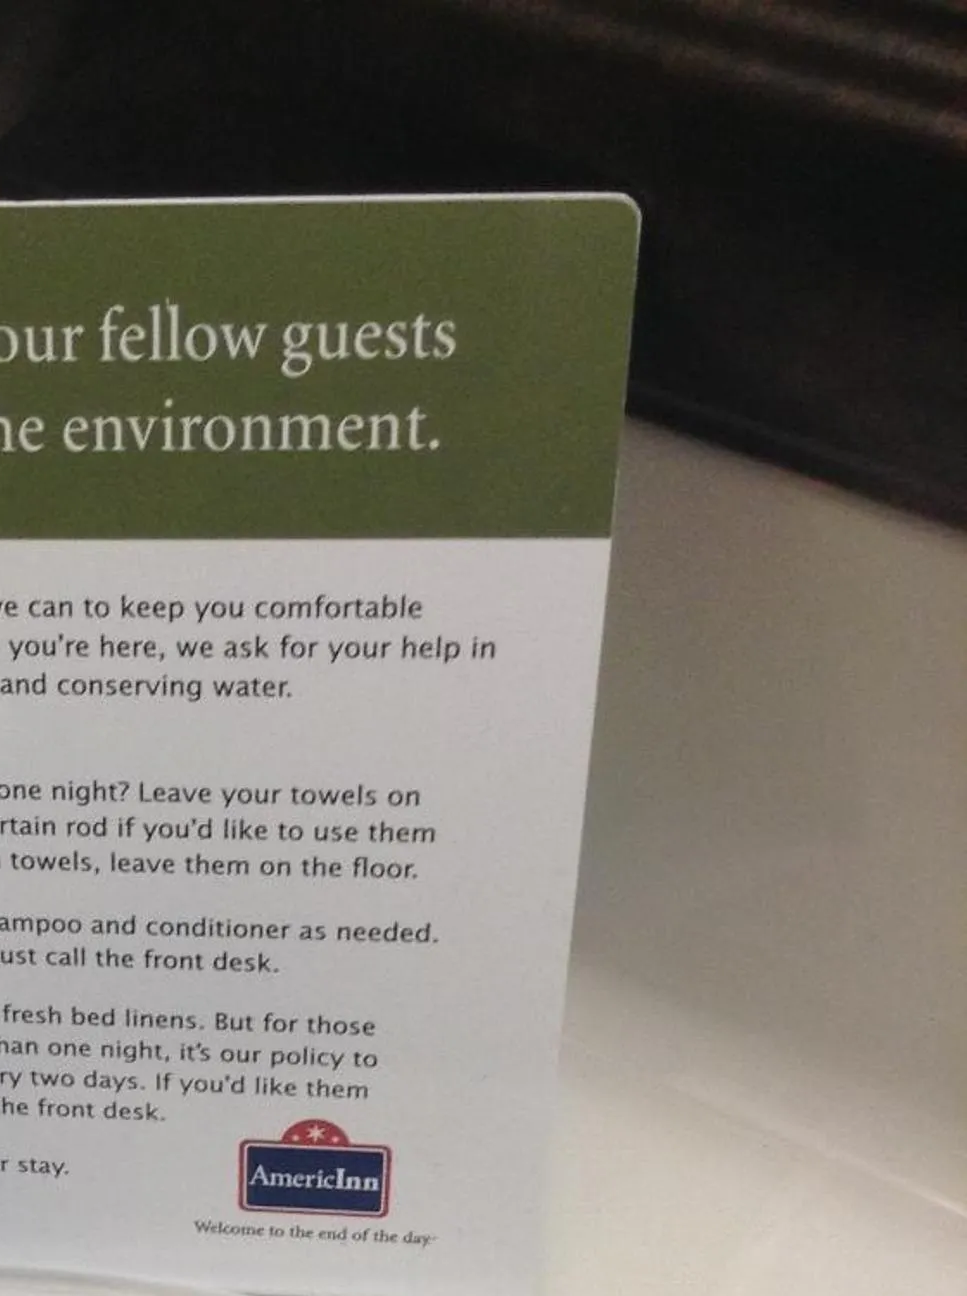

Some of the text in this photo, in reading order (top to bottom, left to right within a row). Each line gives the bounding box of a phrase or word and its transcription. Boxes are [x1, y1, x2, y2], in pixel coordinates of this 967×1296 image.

[99, 303, 268, 363] fellow
[281, 312, 457, 379] guests
[62, 398, 441, 452] environment.
[27, 599, 74, 619] can
[82, 597, 111, 619] to
[120, 593, 186, 624] keep
[193, 600, 245, 625] you
[254, 593, 423, 621] comfortable
[7, 632, 90, 663] you're
[99, 632, 166, 663] here,
[175, 639, 214, 659] we
[223, 634, 270, 660] ask
[279, 633, 320, 660] for
[327, 640, 393, 665] your
[400, 634, 462, 665] help
[471, 635, 497, 660] in
[0, 671, 47, 696] and
[56, 673, 203, 703] conserving
[212, 677, 293, 699] water.
[51, 779, 131, 807] night?
[138, 780, 213, 805] Leave
[220, 787, 283, 809] your
[290, 783, 378, 807] towels
[387, 789, 421, 808] on
[65, 815, 108, 838] rod
[117, 815, 137, 839] if
[142, 817, 213, 844] you'd
[223, 817, 269, 841] like
[277, 821, 305, 842] to
[313, 825, 360, 843] use
[367, 820, 437, 844] them
[9, 849, 101, 876] towels,
[110, 851, 176, 875] leave
[184, 852, 250, 877] them
[259, 859, 292, 877] on
[301, 855, 343, 878] the
[352, 855, 418, 880] floor.
[90, 914, 137, 936] and
[145, 916, 291, 940] conditioner
[298, 924, 327, 941] as
[336, 920, 439, 944] needed.
[45, 946, 86, 967] call
[95, 947, 135, 969] the
[143, 948, 205, 972] front
[211, 950, 280, 974] desk.
[1, 1003, 63, 1026] fresh
[70, 1005, 116, 1028] bed
[125, 1007, 205, 1031] linens.
[214, 1011, 254, 1033] But
[262, 1011, 299, 1034] for
[307, 1014, 376, 1037] those
[29, 1070, 76, 1088] two
[82, 1069, 146, 1094] days.
[155, 1071, 173, 1092] If
[179, 1074, 246, 1097] you'd
[254, 1075, 298, 1097] like
[306, 1078, 369, 1101] them
[17, 1157, 70, 1179] stay.
[247, 1163, 381, 1192] AmericInn
[193, 1219, 265, 1237] Welcome
[268, 1225, 286, 1238] to
[289, 1224, 315, 1240] the
[317, 1226, 349, 1242] end
[351, 1227, 371, 1243] of
[372, 1228, 399, 1244] the
